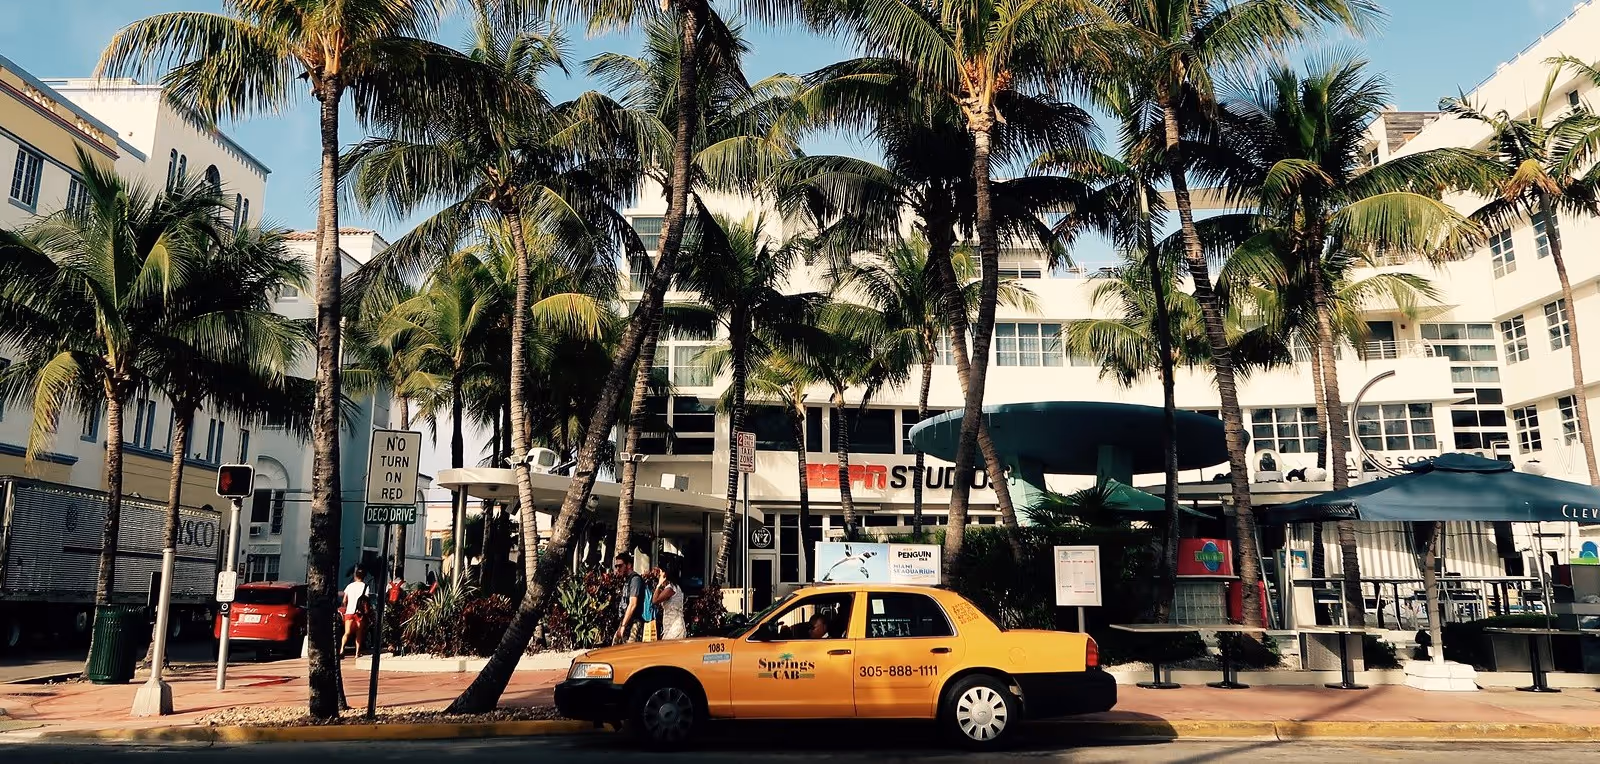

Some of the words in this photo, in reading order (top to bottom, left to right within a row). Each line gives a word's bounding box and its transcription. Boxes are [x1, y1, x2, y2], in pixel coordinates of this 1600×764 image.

[387, 437, 406, 451] NO
[381, 455, 409, 467] TURN
[740, 455, 753, 463] ZONE
[385, 472, 402, 483] ON
[806, 463, 887, 489] ESPN
[381, 488, 403, 500] RED
[367, 508, 388, 521] DECO
[390, 508, 415, 521] DRIVE
[1562, 504, 1598, 518] CLEV
[178, 519, 214, 547] YSCO
[708, 643, 725, 653] 1083
[758, 658, 815, 672] Springs
[859, 665, 938, 677] 305-888-1111
[773, 670, 800, 679] CAB
